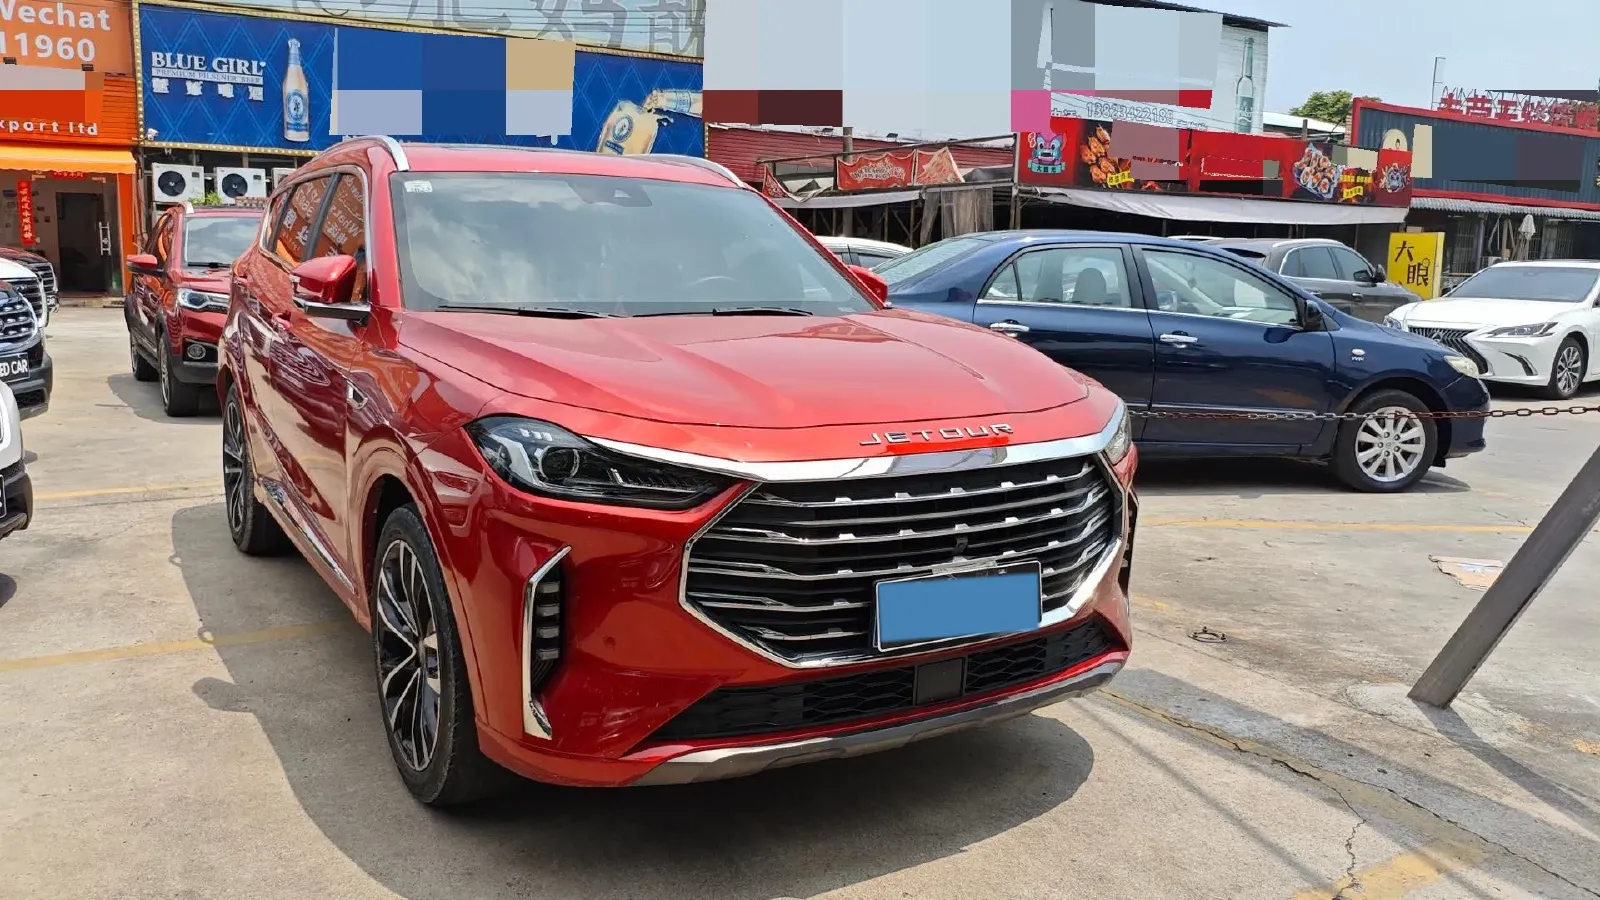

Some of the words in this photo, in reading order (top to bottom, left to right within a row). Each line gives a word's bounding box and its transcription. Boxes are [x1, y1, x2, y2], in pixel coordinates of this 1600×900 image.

[151, 51, 207, 70] BLUE
[212, 56, 264, 76] GIRL
[155, 68, 196, 79] PREMIUM
[198, 71, 237, 82] PILSENER
[241, 75, 261, 84] BEER
[69, 121, 98, 136] ltd
[11, 359, 28, 375] CAR
[859, 423, 1014, 445] JETOUR
